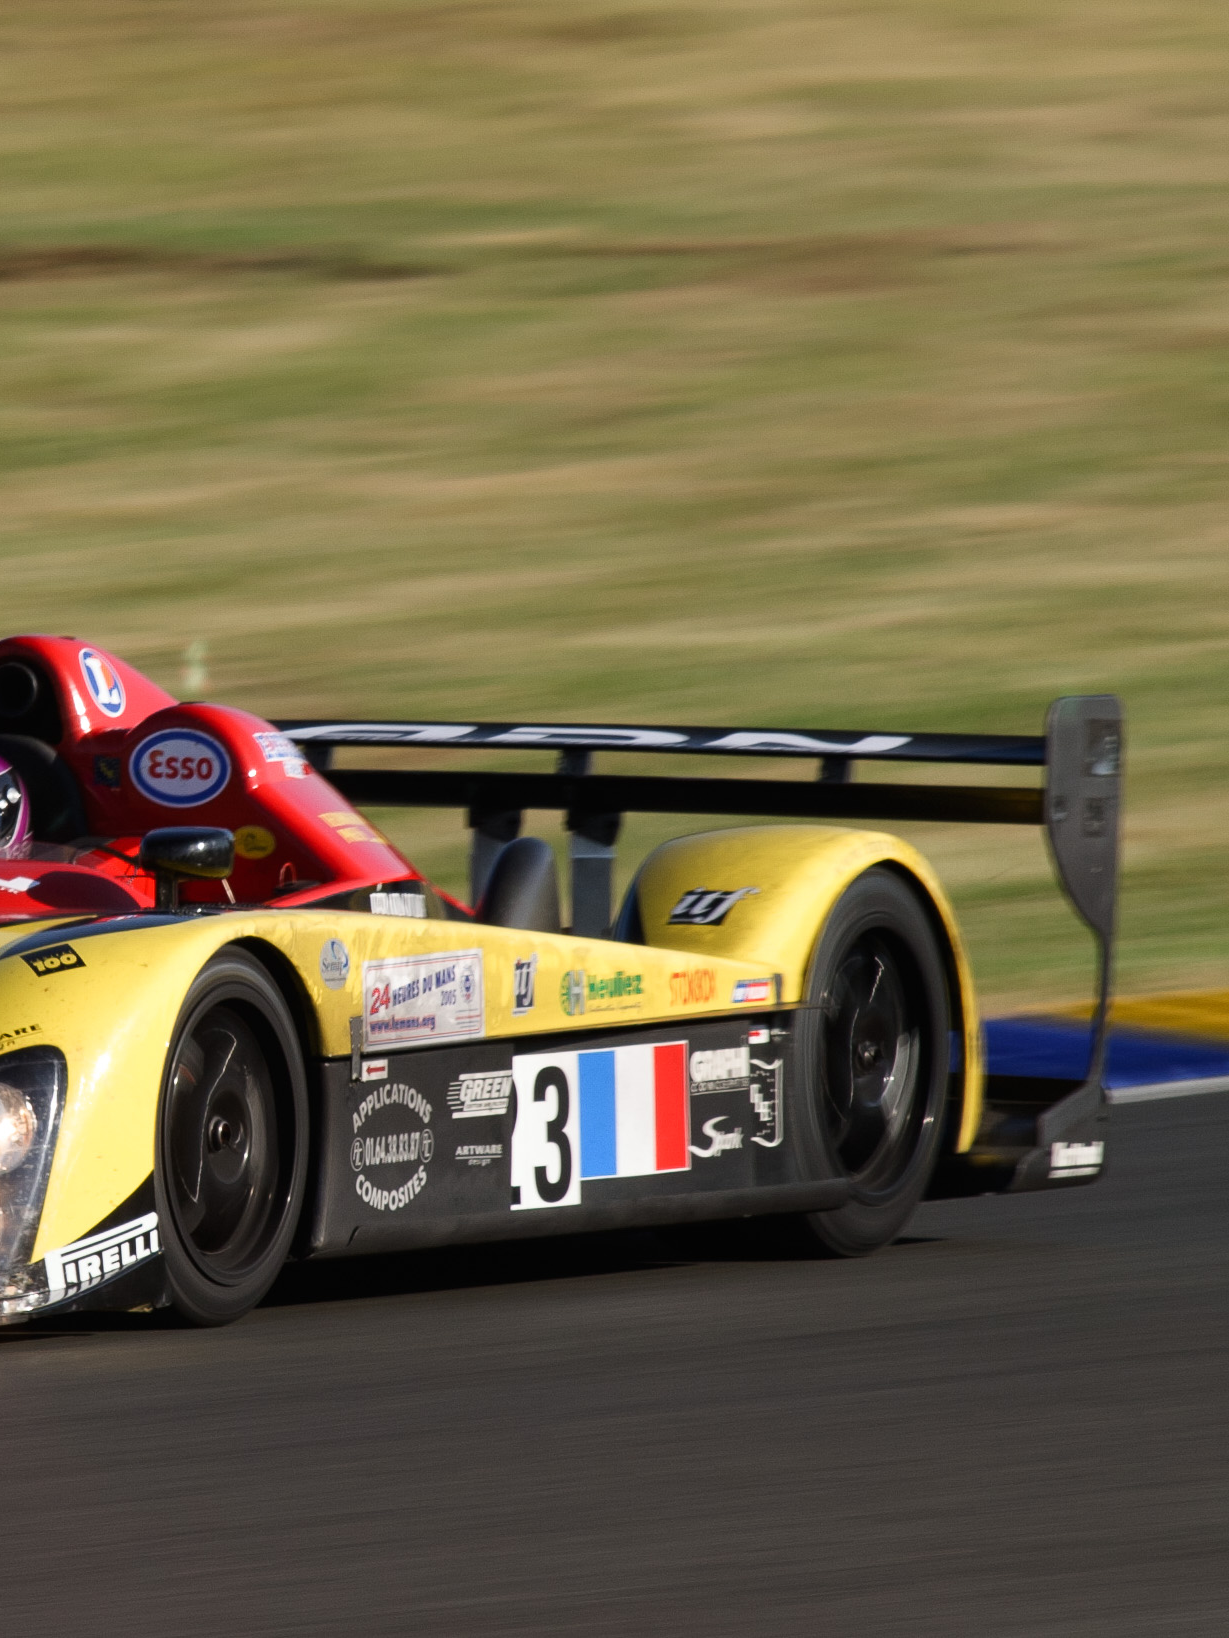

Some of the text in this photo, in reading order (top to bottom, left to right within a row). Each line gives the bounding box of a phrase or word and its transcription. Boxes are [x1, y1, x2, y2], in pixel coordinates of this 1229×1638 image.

[33, 952, 78, 972] 100
[369, 984, 391, 1016] 24
[392, 979, 420, 1007] HEURES
[422, 976, 433, 995] DU
[435, 964, 456, 989] MANS
[369, 1015, 436, 1033] www.lemans.org
[459, 1076, 513, 1102] GREEN
[352, 1083, 433, 1134] APPLICATIONS
[455, 1144, 503, 1156] ARTWARE
[355, 1165, 428, 1212] COMPOSITES
[44, 1212, 159, 1291] PIRELLI
